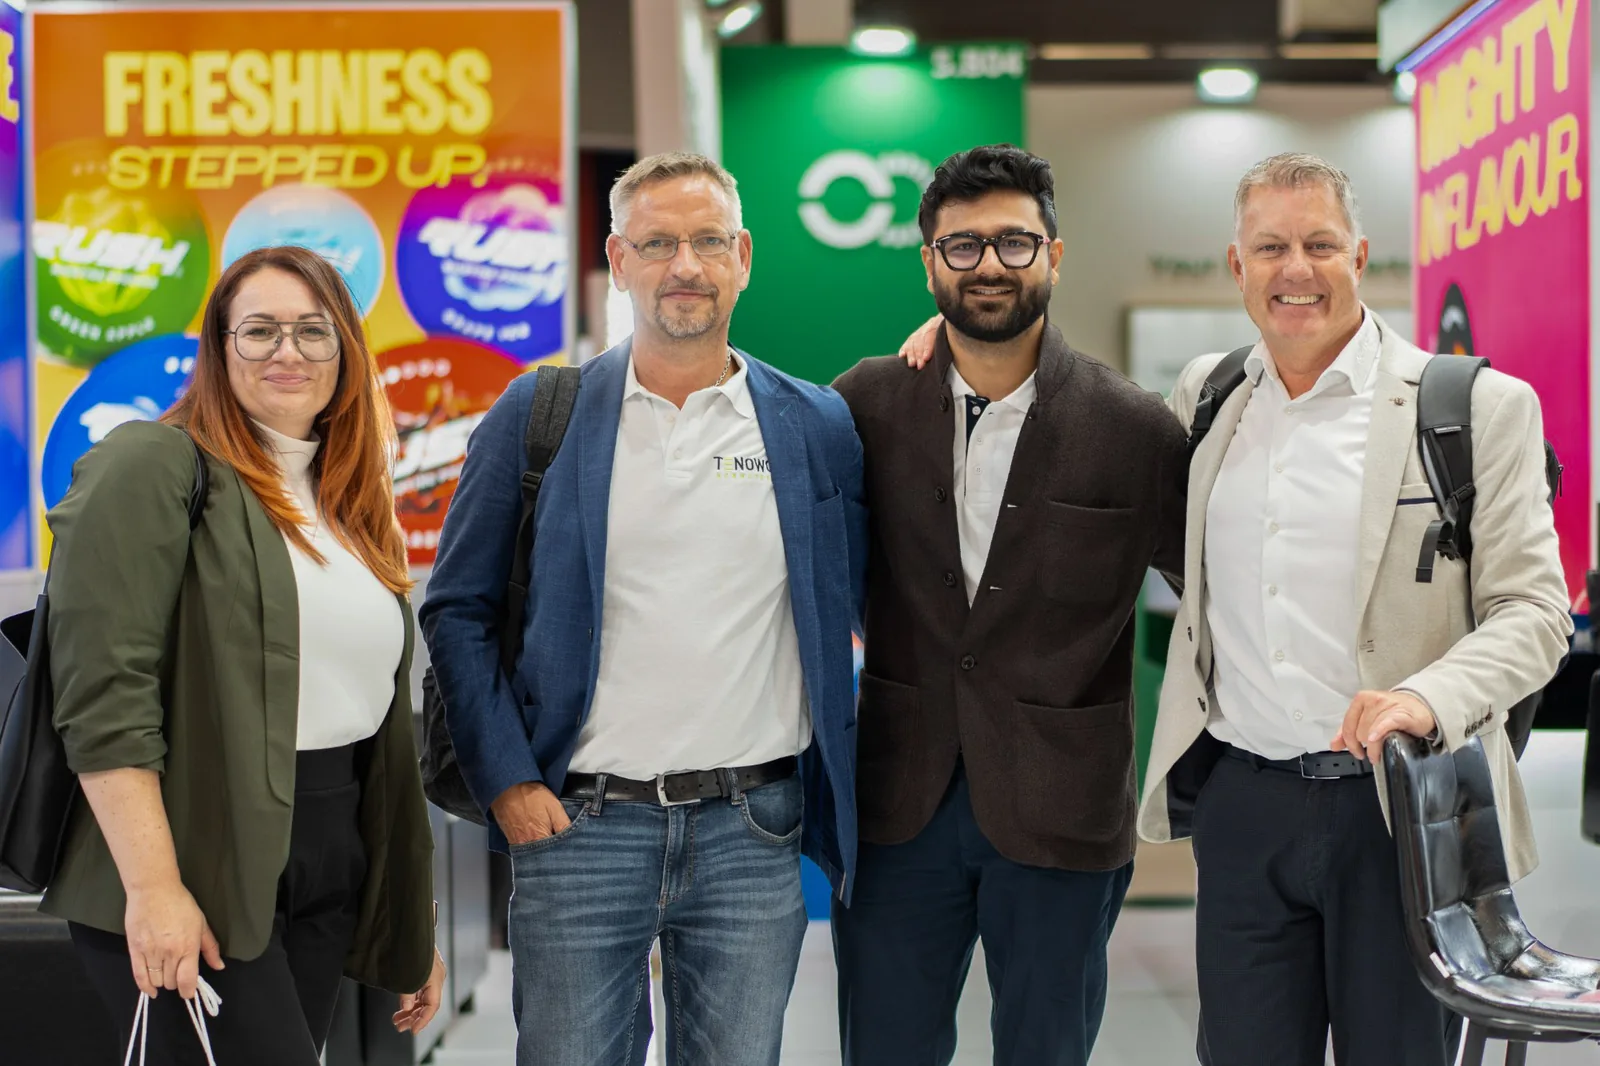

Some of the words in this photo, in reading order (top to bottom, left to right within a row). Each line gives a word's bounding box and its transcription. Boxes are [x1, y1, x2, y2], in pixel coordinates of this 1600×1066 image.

[104, 48, 493, 137] FRESHNESS
[1419, 0, 1577, 172] MIGHTY
[107, 144, 389, 189] STEPPED
